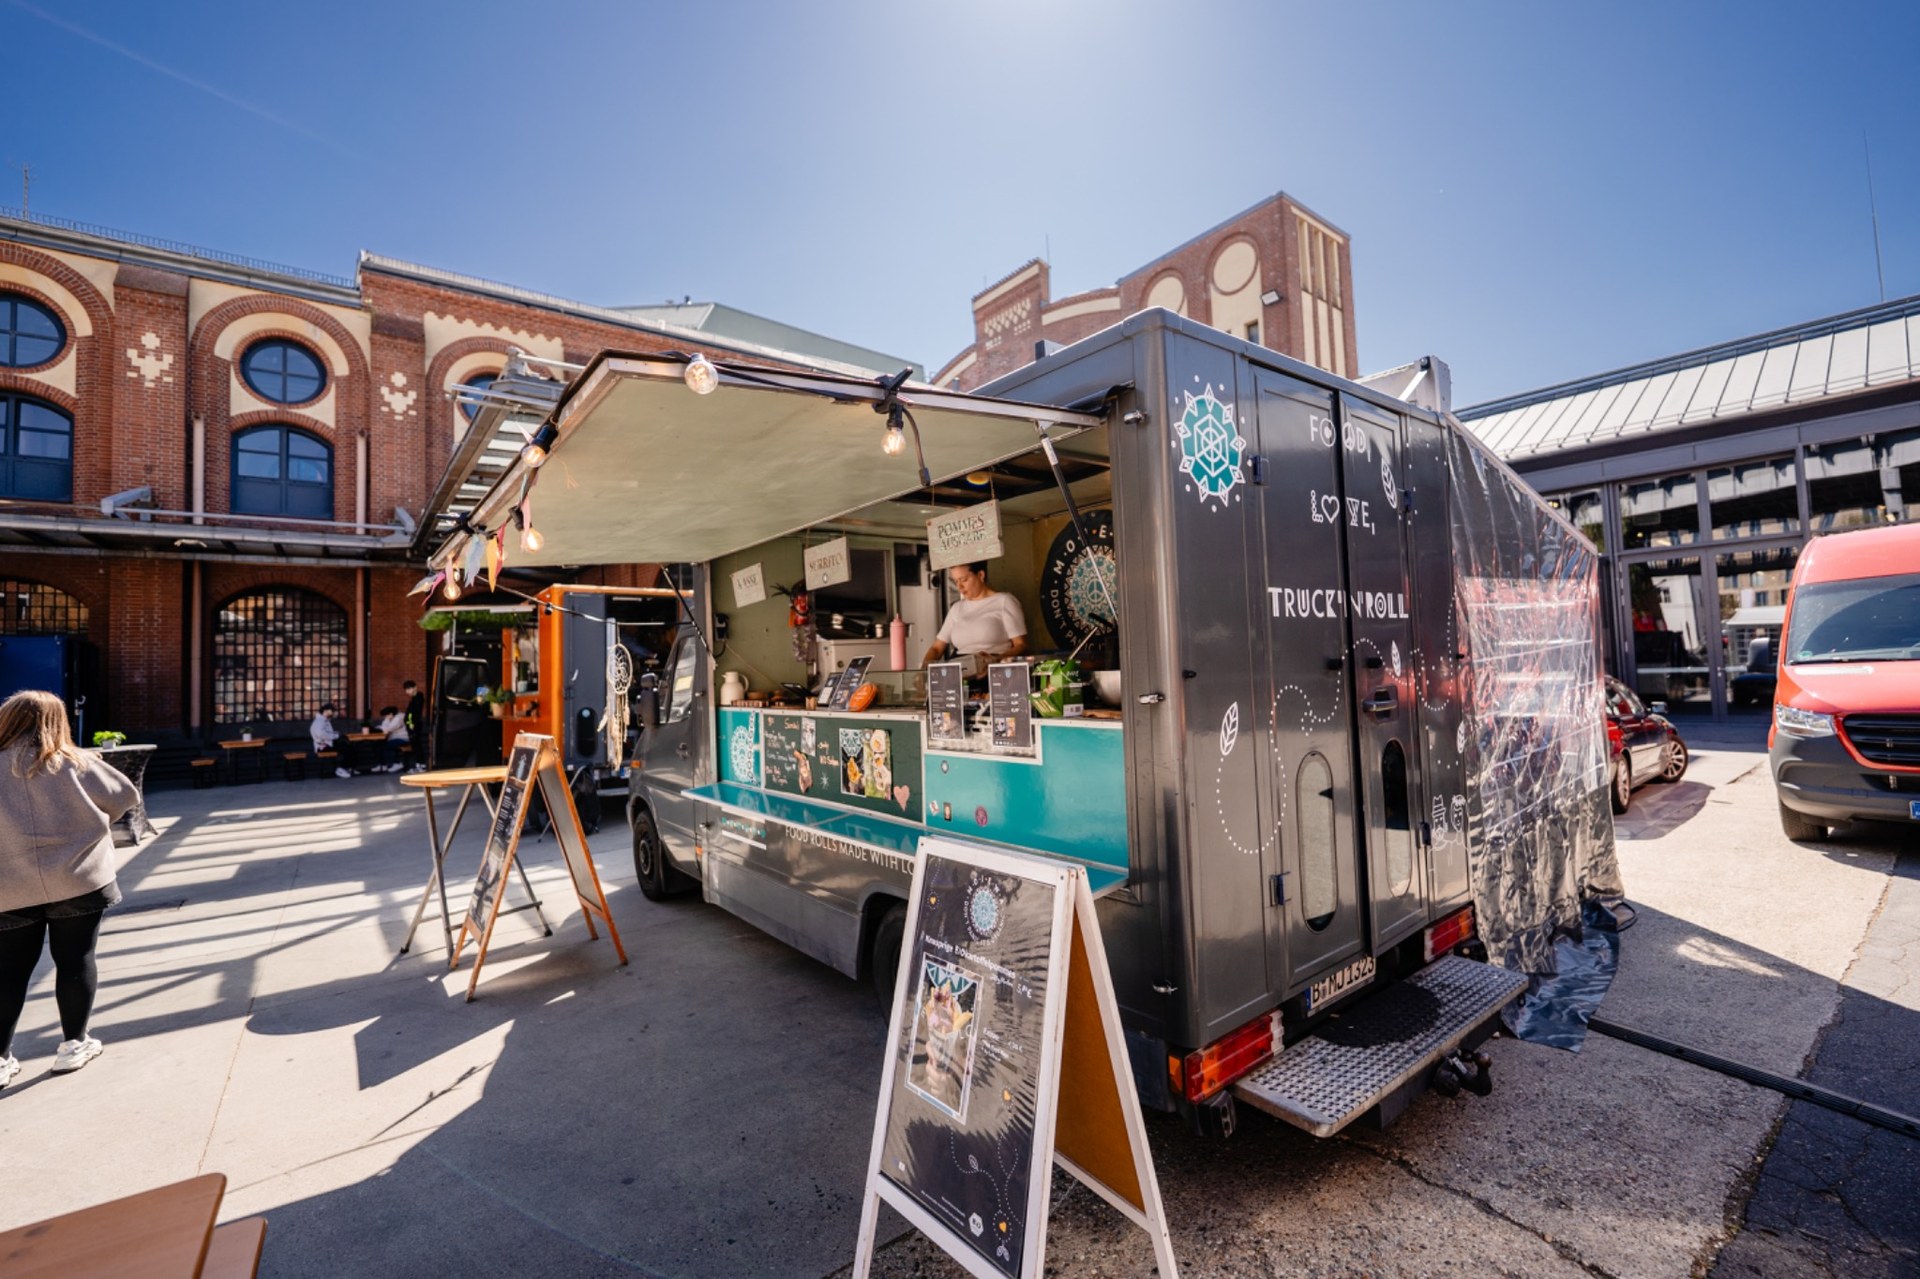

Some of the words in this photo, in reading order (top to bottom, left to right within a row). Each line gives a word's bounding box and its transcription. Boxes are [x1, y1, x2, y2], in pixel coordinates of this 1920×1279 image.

[785, 825, 808, 843] FOOD
[810, 833, 838, 852] ROLLS
[839, 842, 868, 861] MADE
[869, 851, 899, 871] WITH
